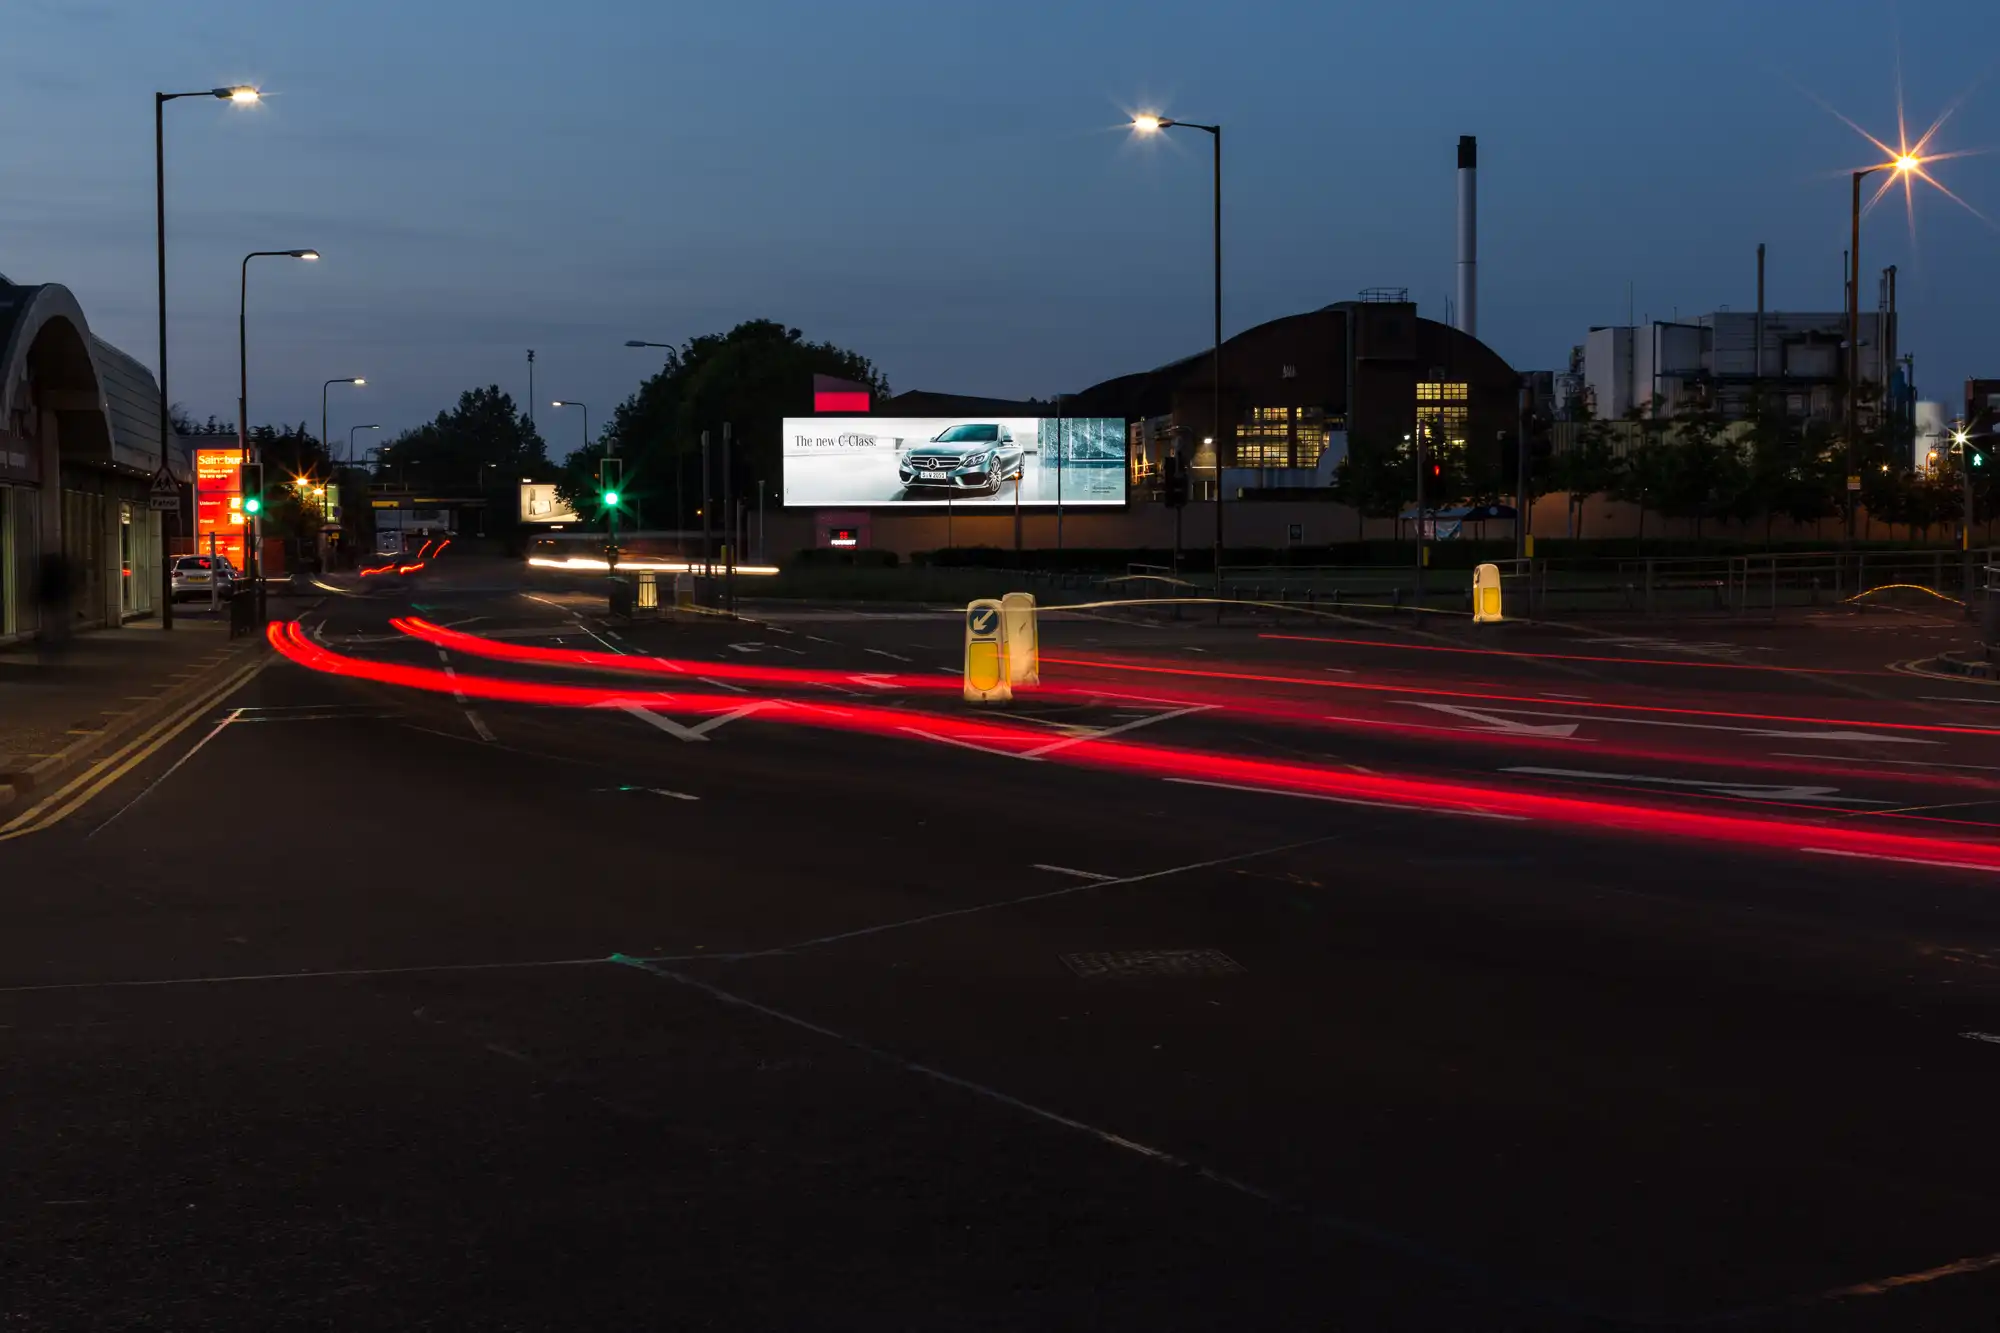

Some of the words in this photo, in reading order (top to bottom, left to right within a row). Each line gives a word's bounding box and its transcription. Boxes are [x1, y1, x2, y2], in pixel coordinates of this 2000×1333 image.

[795, 435, 812, 447] The
[816, 437, 834, 447] new
[838, 435, 877, 447] C-Class.
